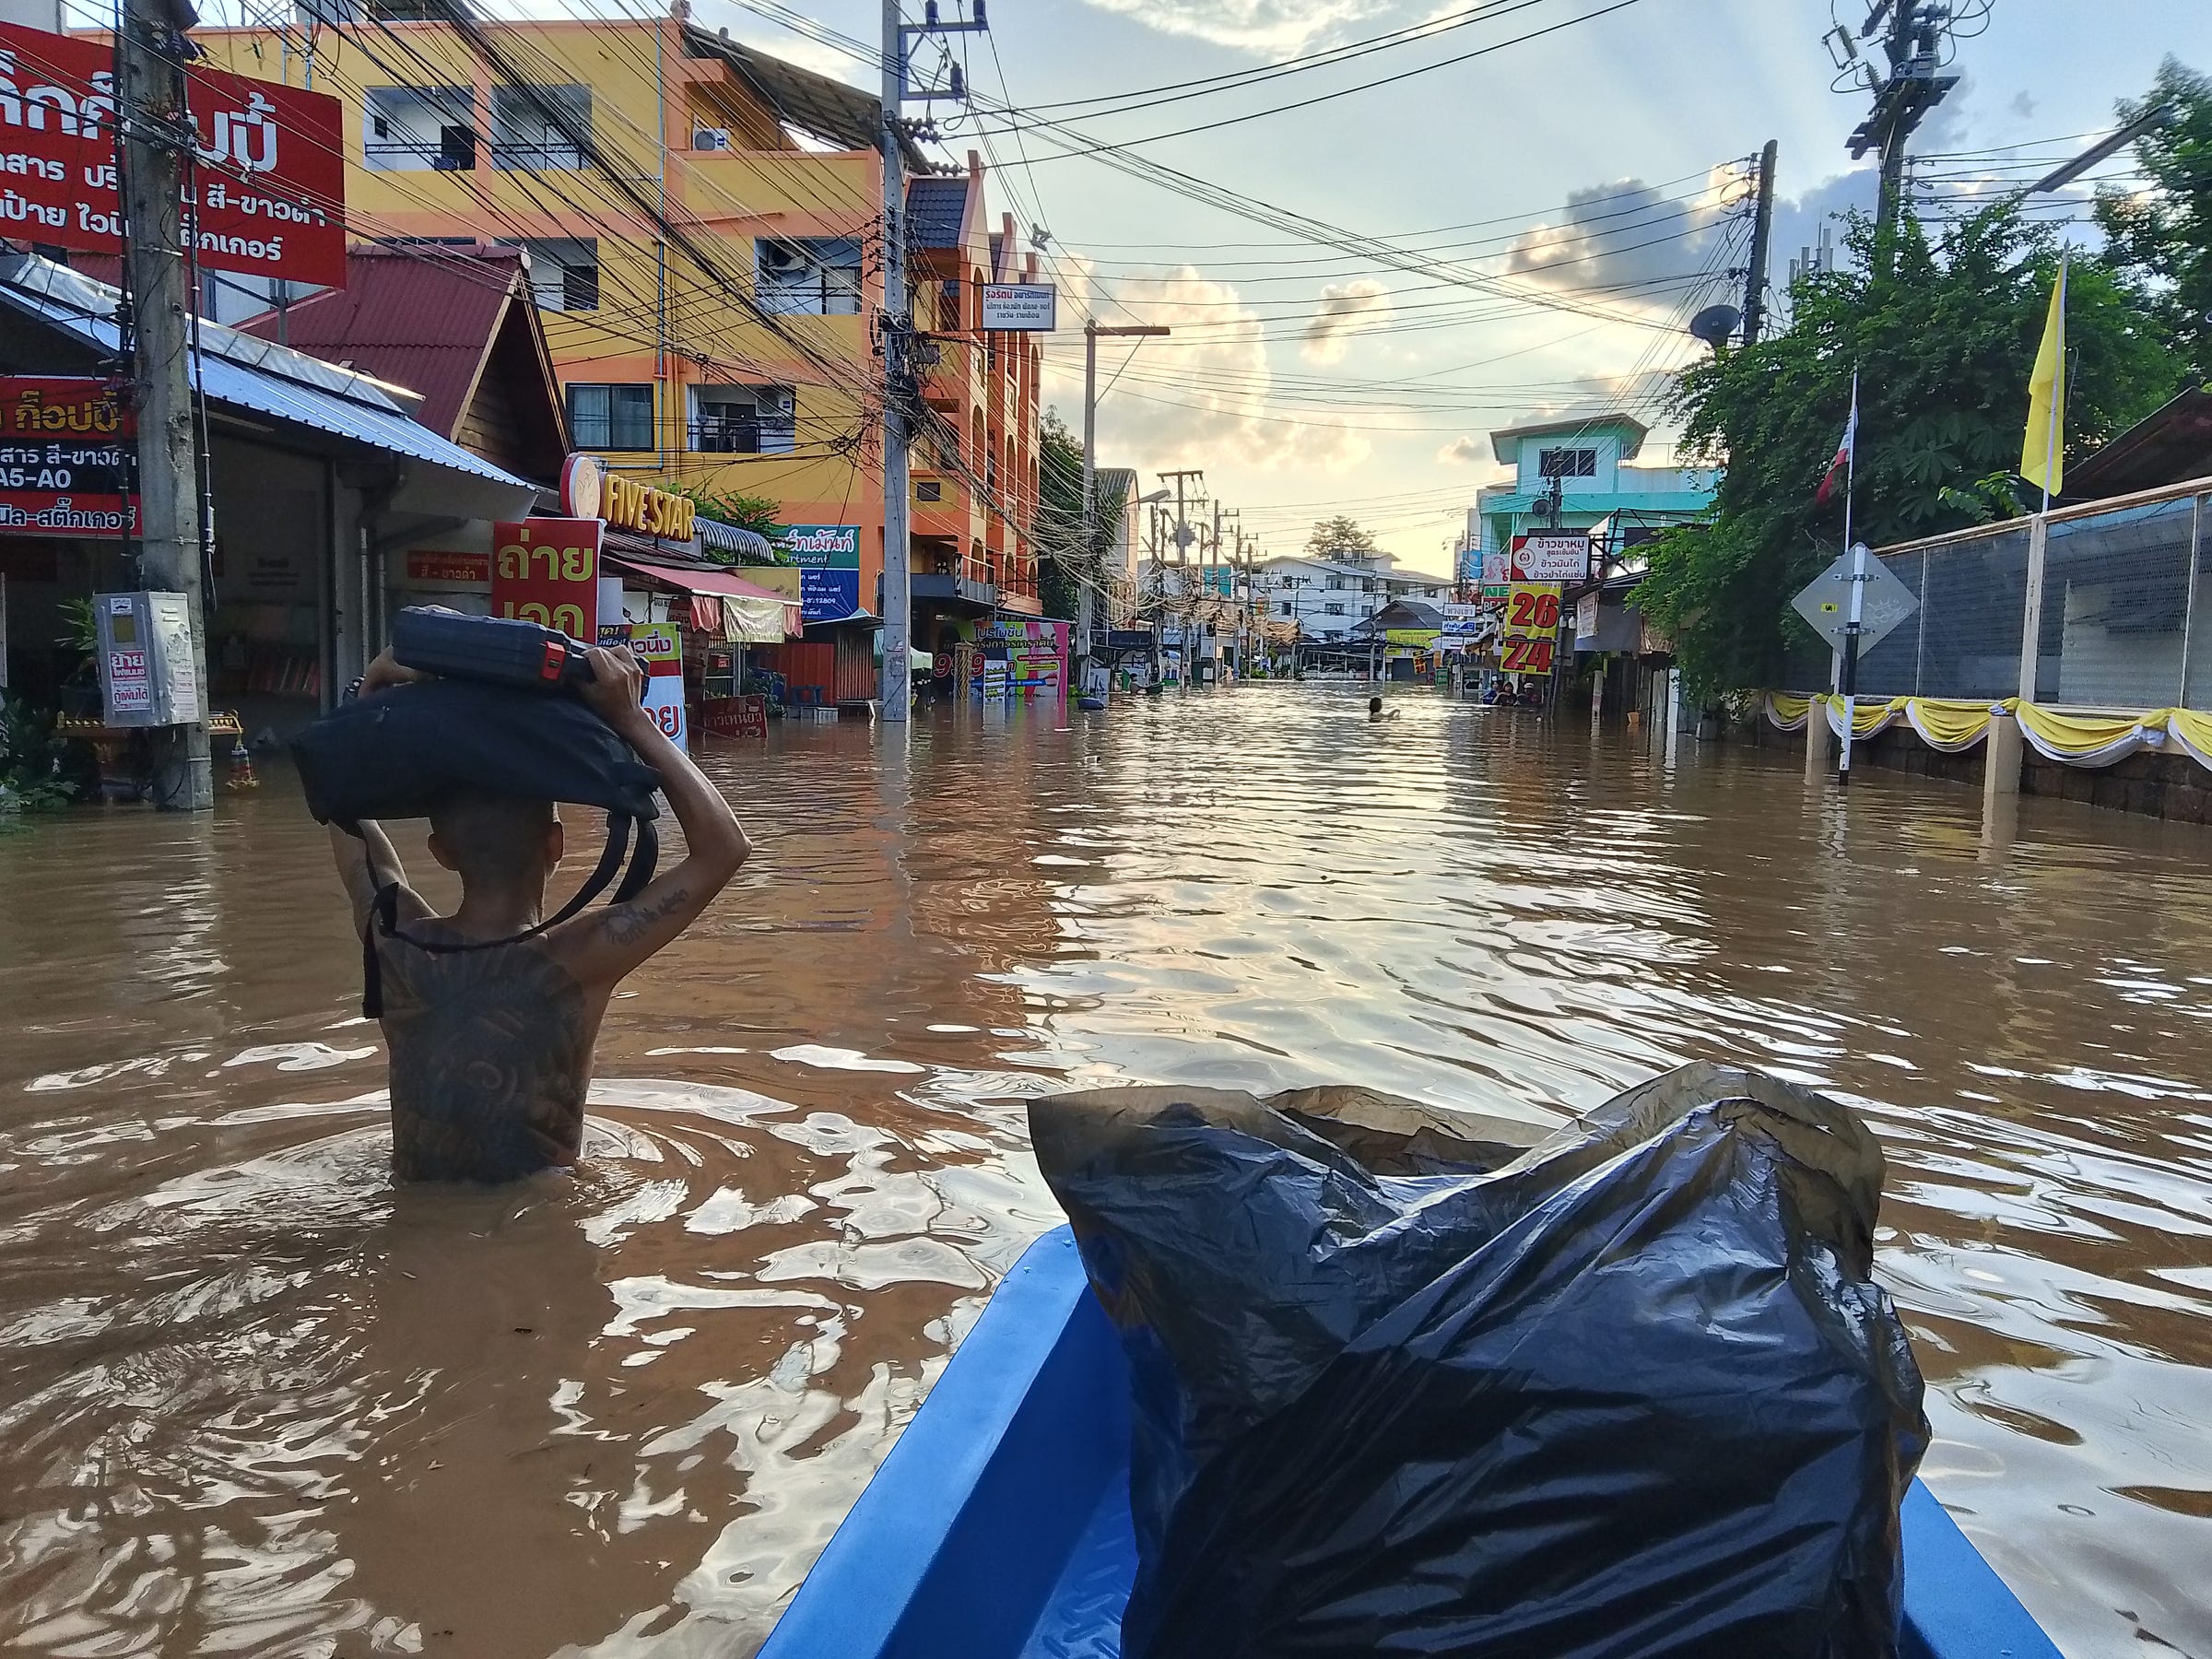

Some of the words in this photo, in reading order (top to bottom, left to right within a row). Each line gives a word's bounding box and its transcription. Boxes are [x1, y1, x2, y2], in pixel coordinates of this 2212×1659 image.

[0, 468, 72, 488] A5-A0
[604, 474, 649, 530] FIVE
[650, 491, 696, 542] STAR
[498, 529, 594, 582] ถ่าย
[1536, 537, 1585, 551] ข้าวขาหมู
[1540, 559, 1580, 568] ข้าวมันไก่
[1511, 592, 1559, 629] 26
[974, 625, 1023, 639] โปรโมชั่น
[933, 653, 987, 677] 99
[1502, 633, 1552, 673] 24
